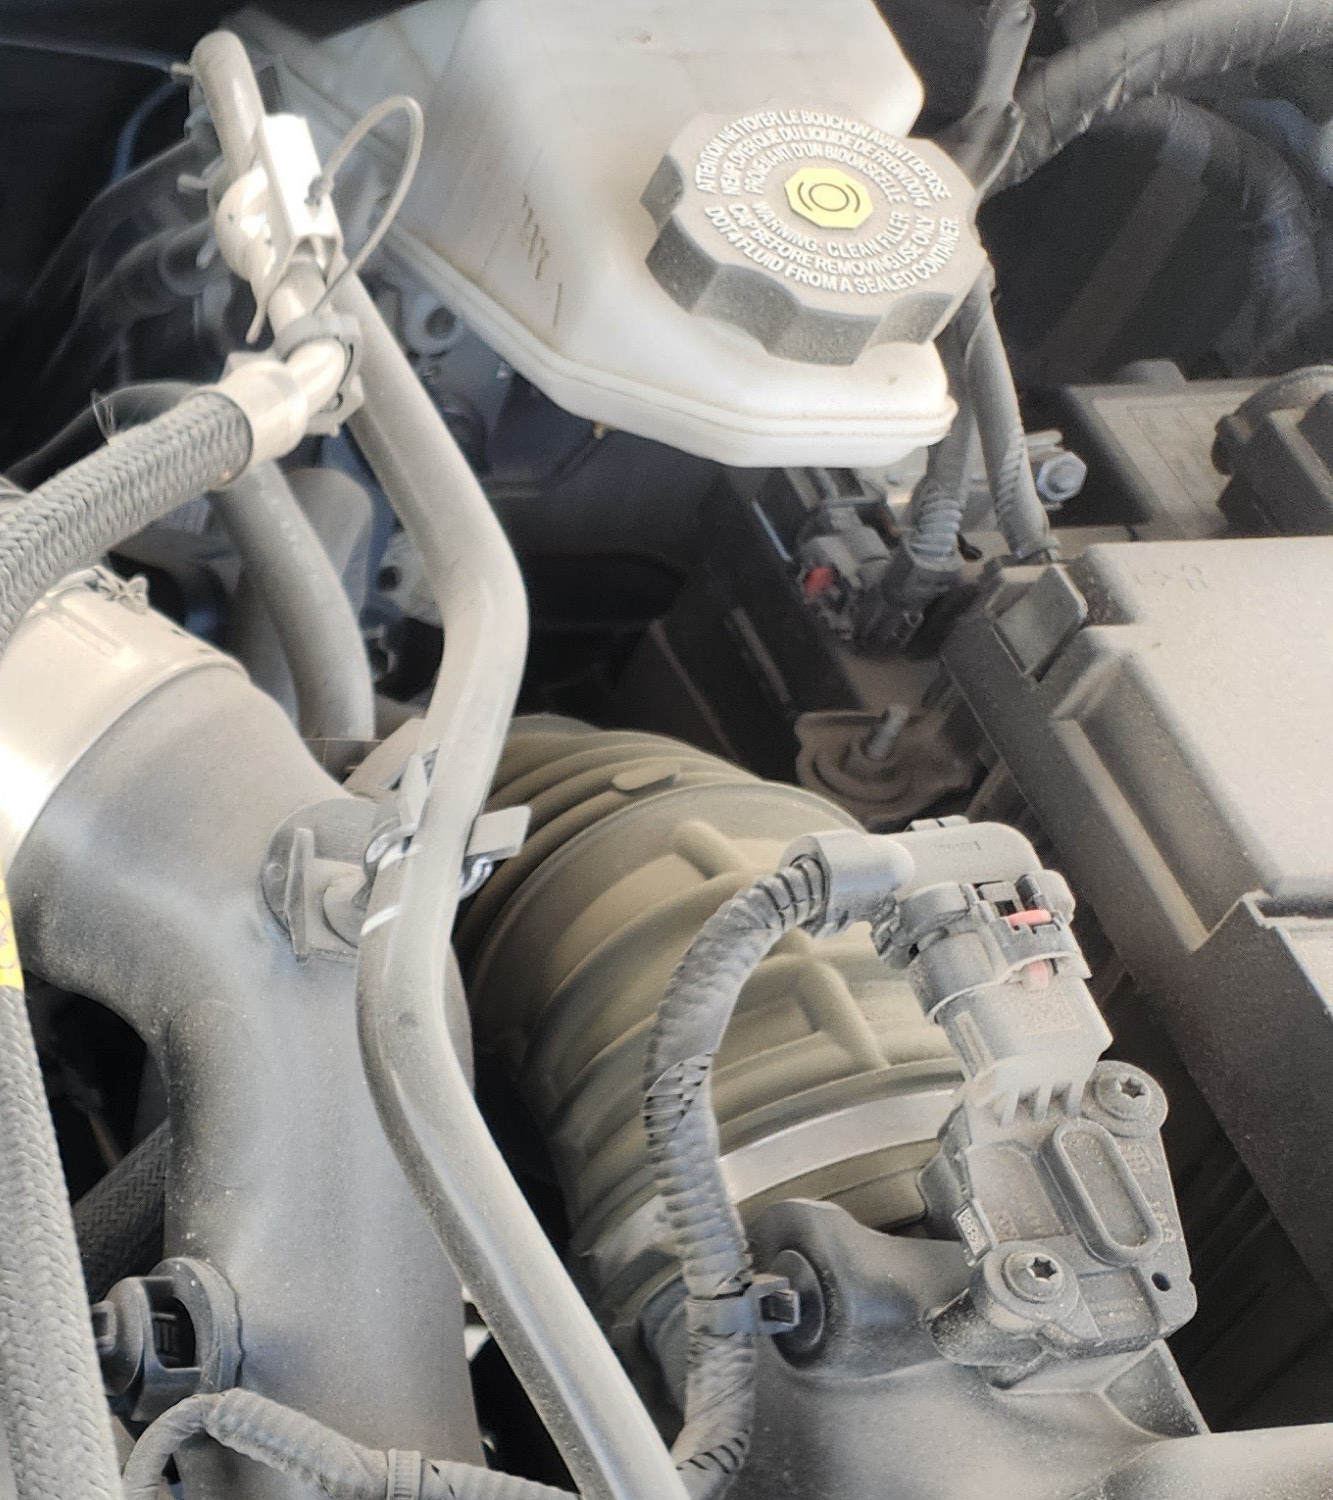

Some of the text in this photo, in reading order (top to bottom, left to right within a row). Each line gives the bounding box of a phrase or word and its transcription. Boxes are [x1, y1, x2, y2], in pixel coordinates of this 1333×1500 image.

[749, 226, 815, 268] BEFORE
[826, 237, 883, 258] CLEAN
[784, 262, 838, 291] FROM
[853, 269, 923, 294] SEALED
